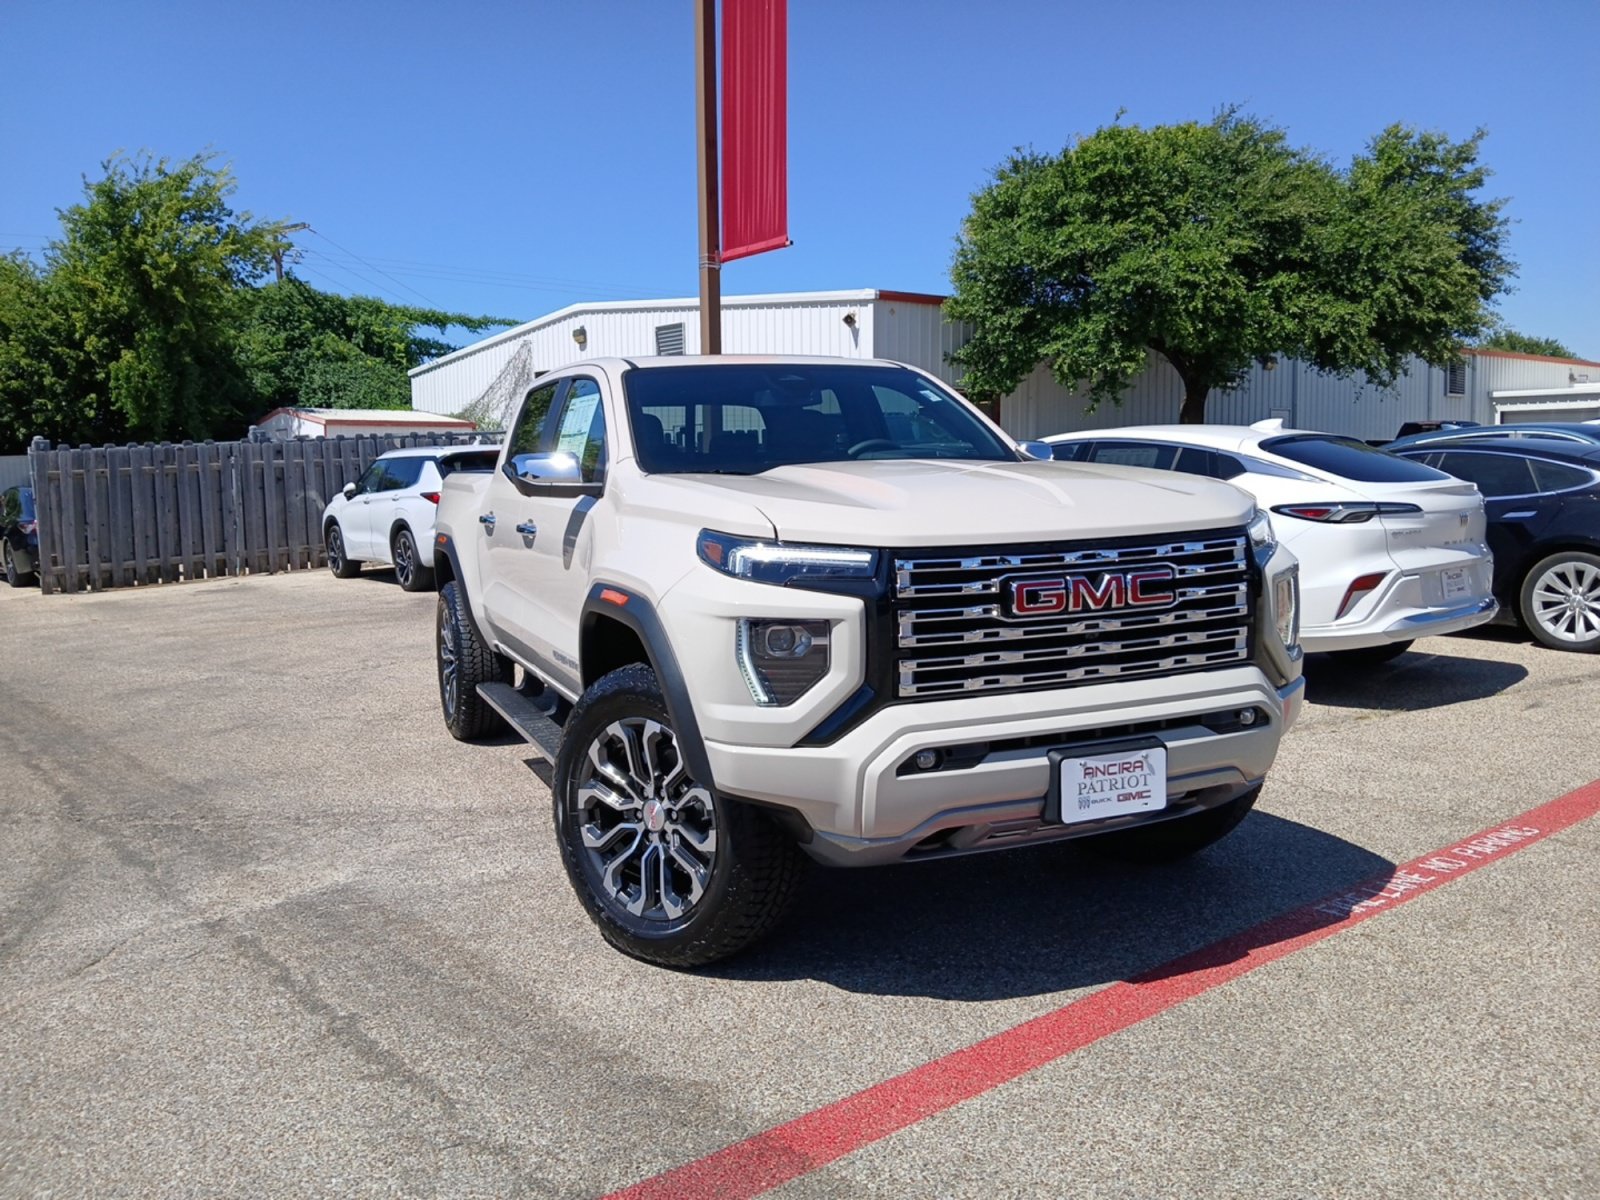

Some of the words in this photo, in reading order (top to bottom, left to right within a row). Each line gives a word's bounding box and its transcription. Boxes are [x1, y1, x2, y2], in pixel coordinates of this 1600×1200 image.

[1010, 569, 1174, 615] GMC
[1083, 760, 1144, 779] ANCIRA
[1077, 773, 1152, 795] PATRIOT
[1117, 789, 1151, 802] GMC
[1361, 869, 1437, 899] LANE
[1418, 856, 1468, 873] NO
[1450, 825, 1540, 859] PARKING
